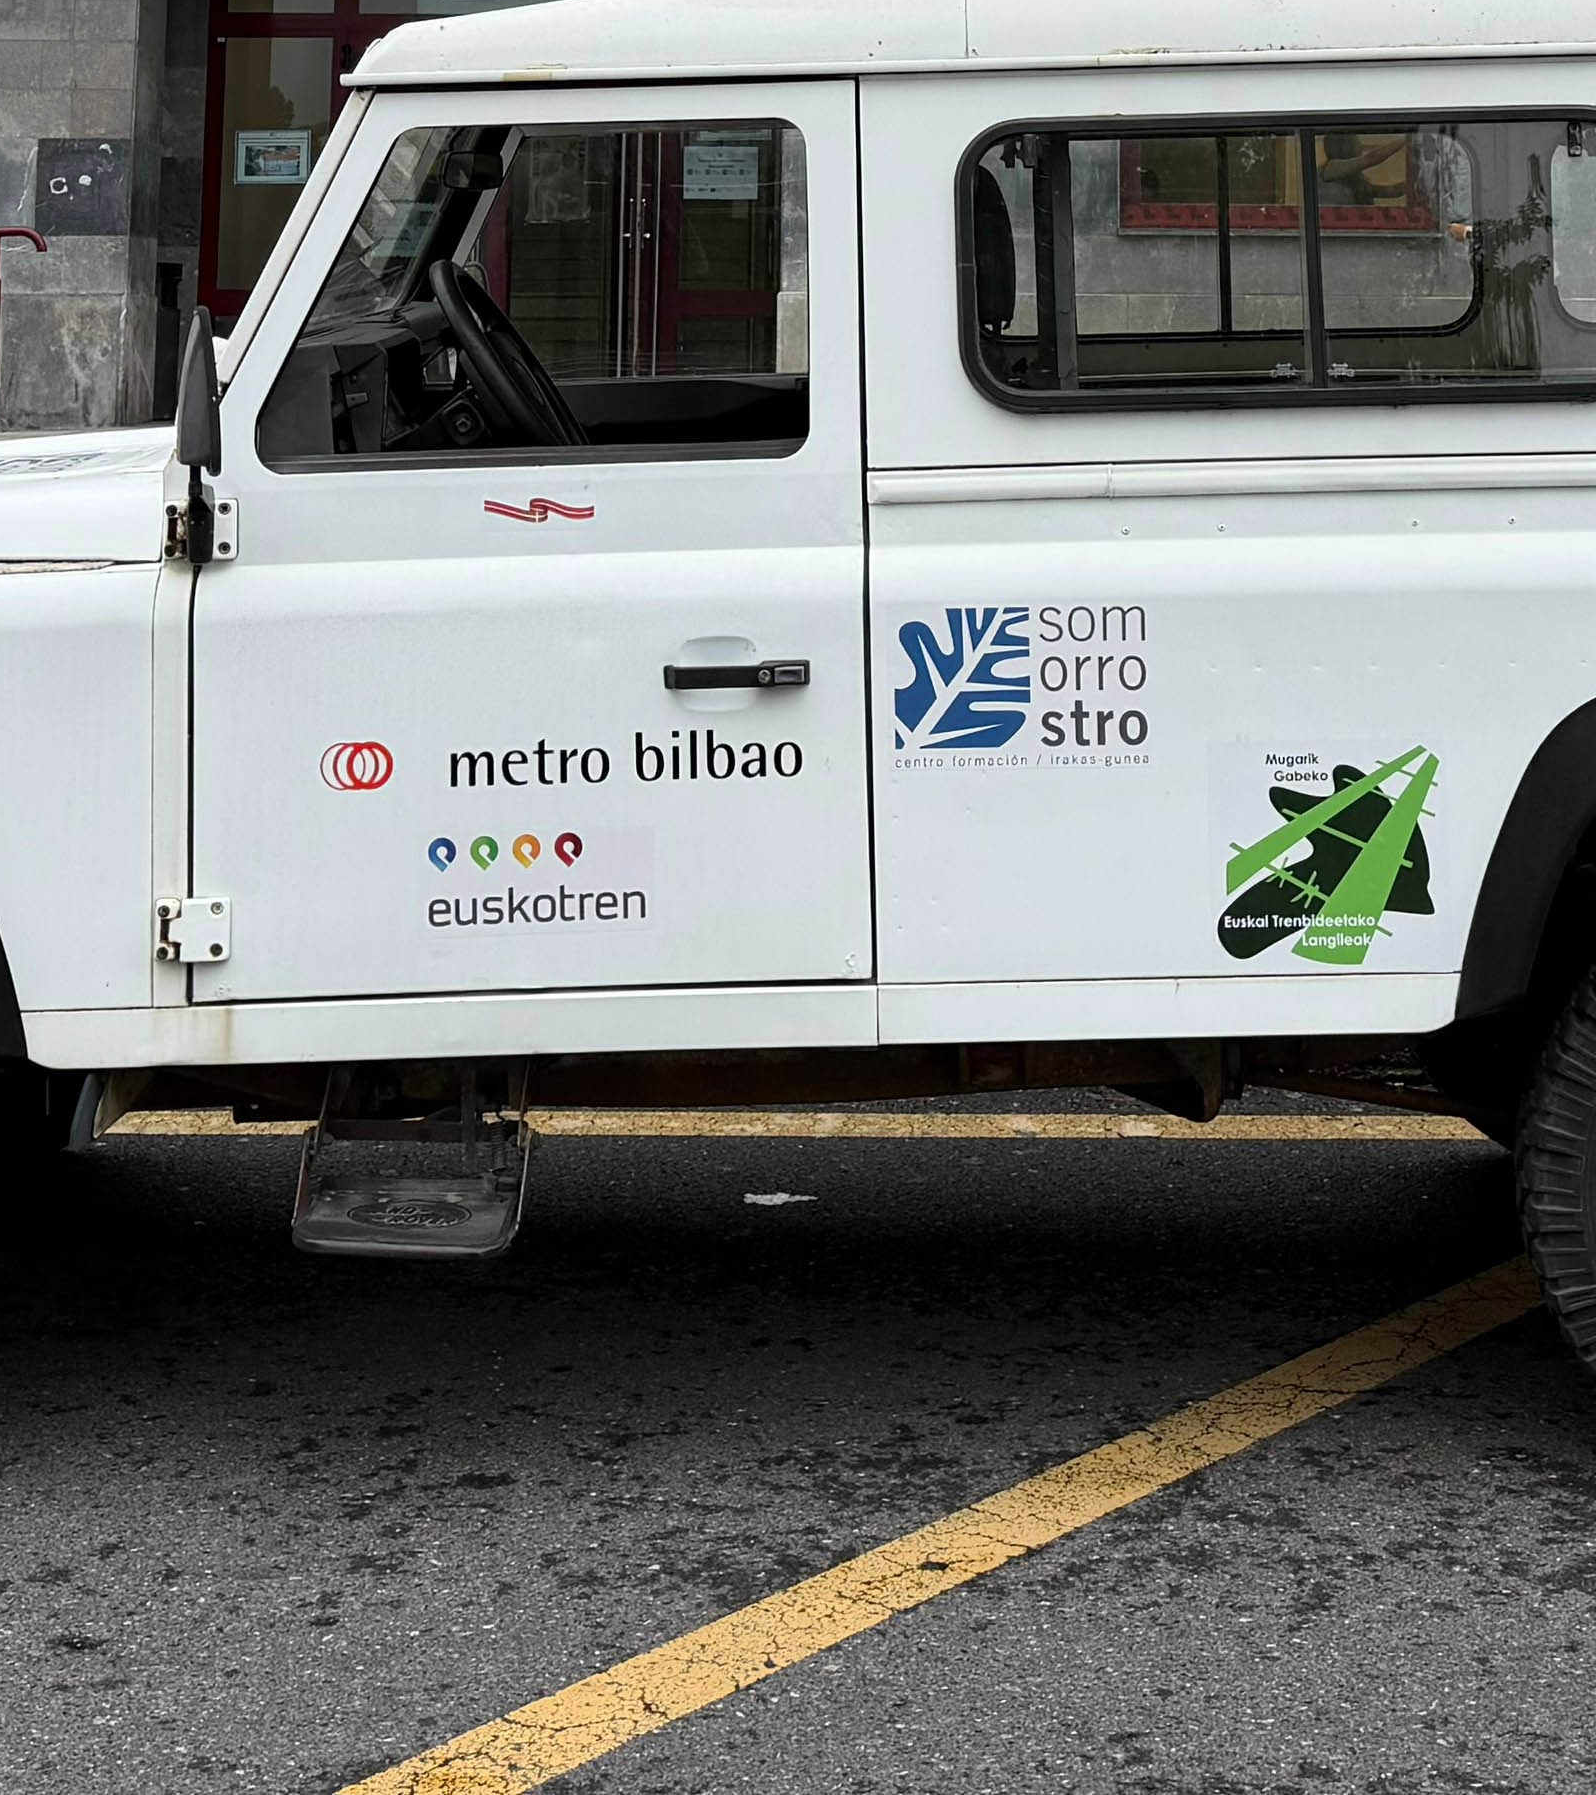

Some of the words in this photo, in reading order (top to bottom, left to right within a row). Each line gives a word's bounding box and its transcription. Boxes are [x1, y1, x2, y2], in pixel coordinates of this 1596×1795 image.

[1039, 605, 1146, 642] som
[1040, 655, 1147, 692] orro
[1040, 699, 1148, 747] stro
[449, 738, 610, 787] metro
[635, 730, 804, 782] bilbao
[895, 756, 944, 769] centro
[952, 754, 1029, 767] formación
[1050, 754, 1150, 767] irakas-gunea
[1265, 753, 1319, 768] Mugarik
[1274, 770, 1329, 782] Gabeko
[427, 883, 647, 927] euskotren
[1224, 914, 1269, 929] Euskal
[1272, 913, 1376, 928] Trenbideetako
